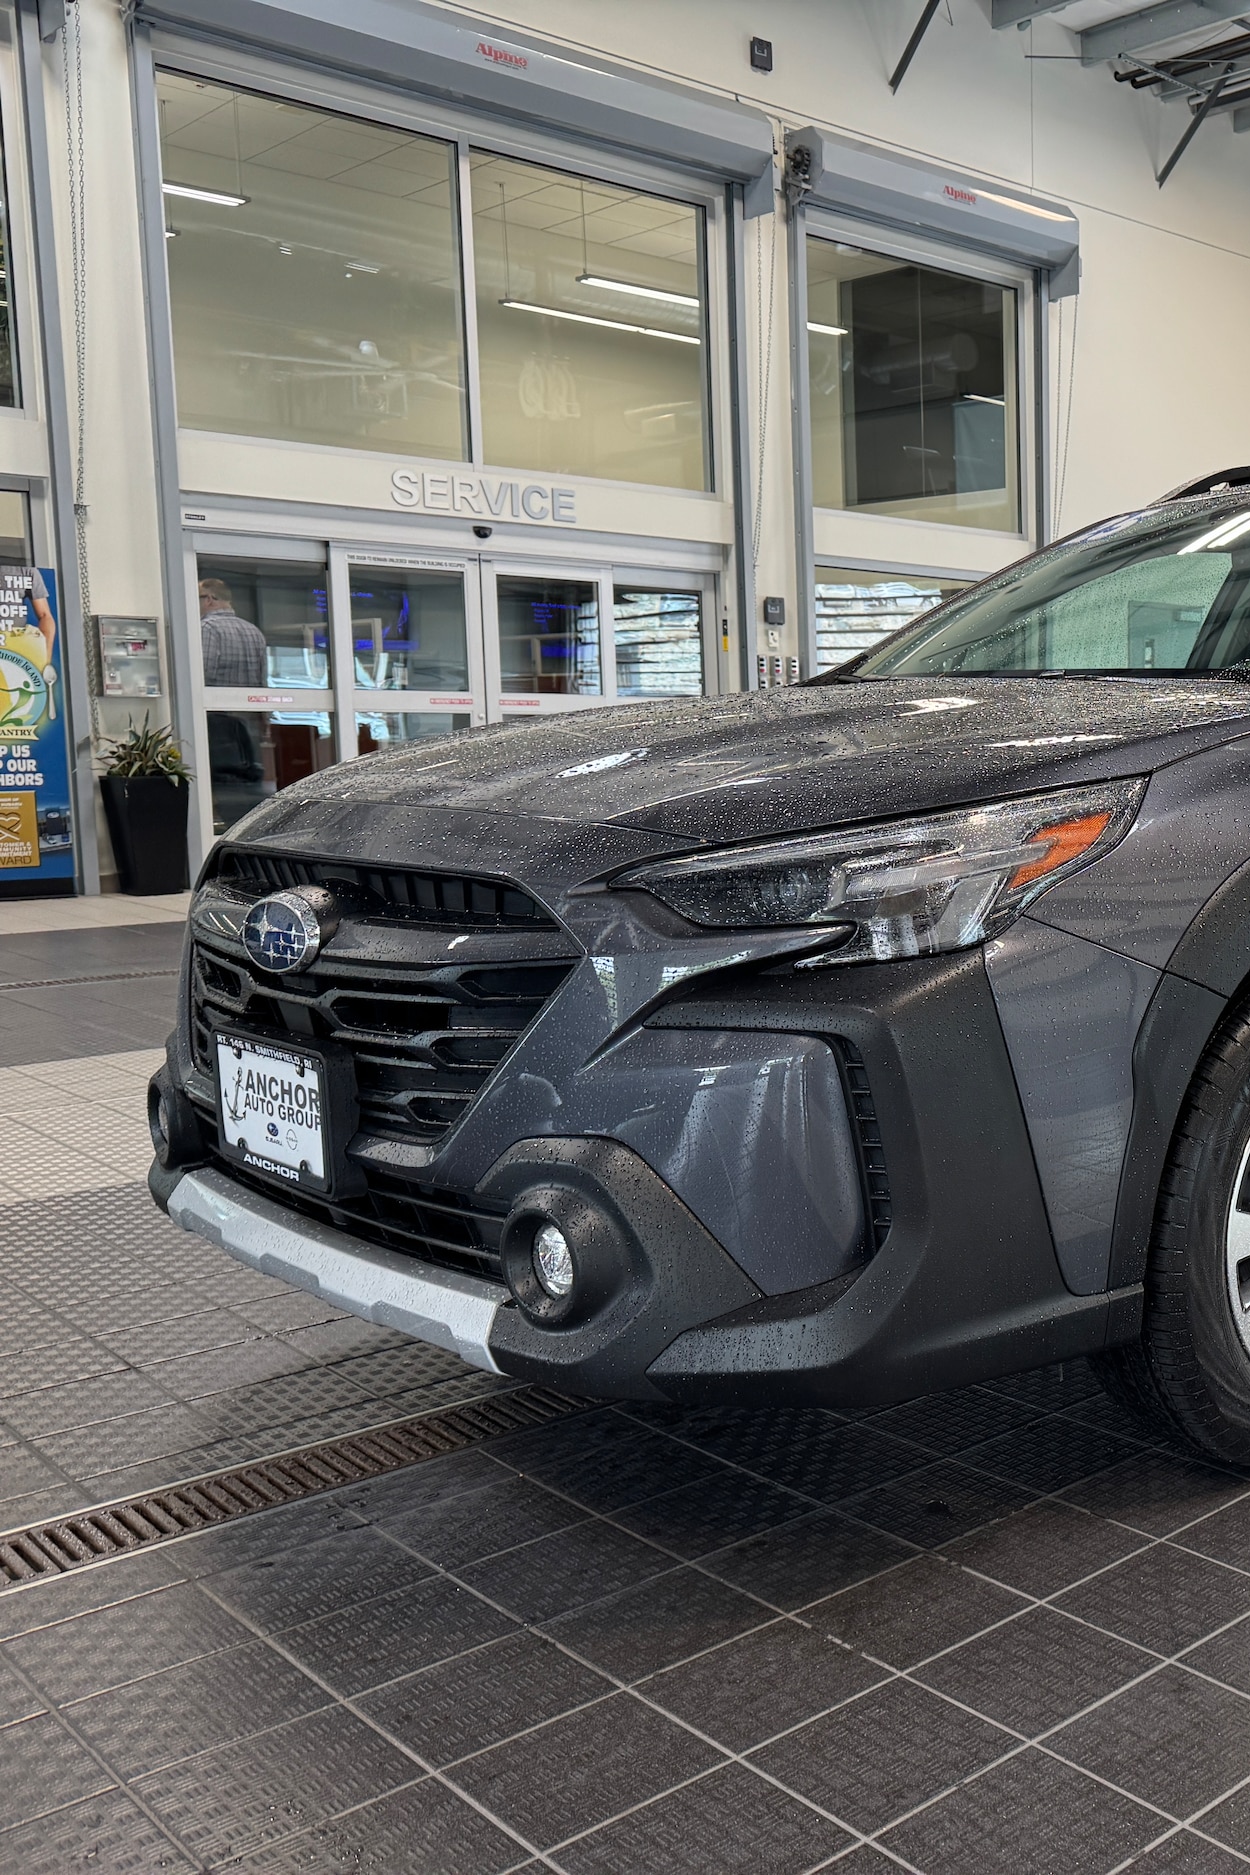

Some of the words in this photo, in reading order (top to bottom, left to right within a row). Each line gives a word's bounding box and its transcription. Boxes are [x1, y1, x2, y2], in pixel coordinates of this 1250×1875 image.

[476, 42, 528, 67] Alpine
[390, 467, 578, 523] SERVICE
[4, 575, 33, 589] THE
[6, 758, 37, 772] OUR
[11, 744, 31, 758] US
[217, 1034, 229, 1046] RT.
[304, 1059, 313, 1070] RI
[245, 1069, 320, 1114] ANCHOR
[244, 1093, 274, 1117] AUTO
[278, 1105, 322, 1131] GROUP
[243, 1153, 300, 1182] ANCHOR
